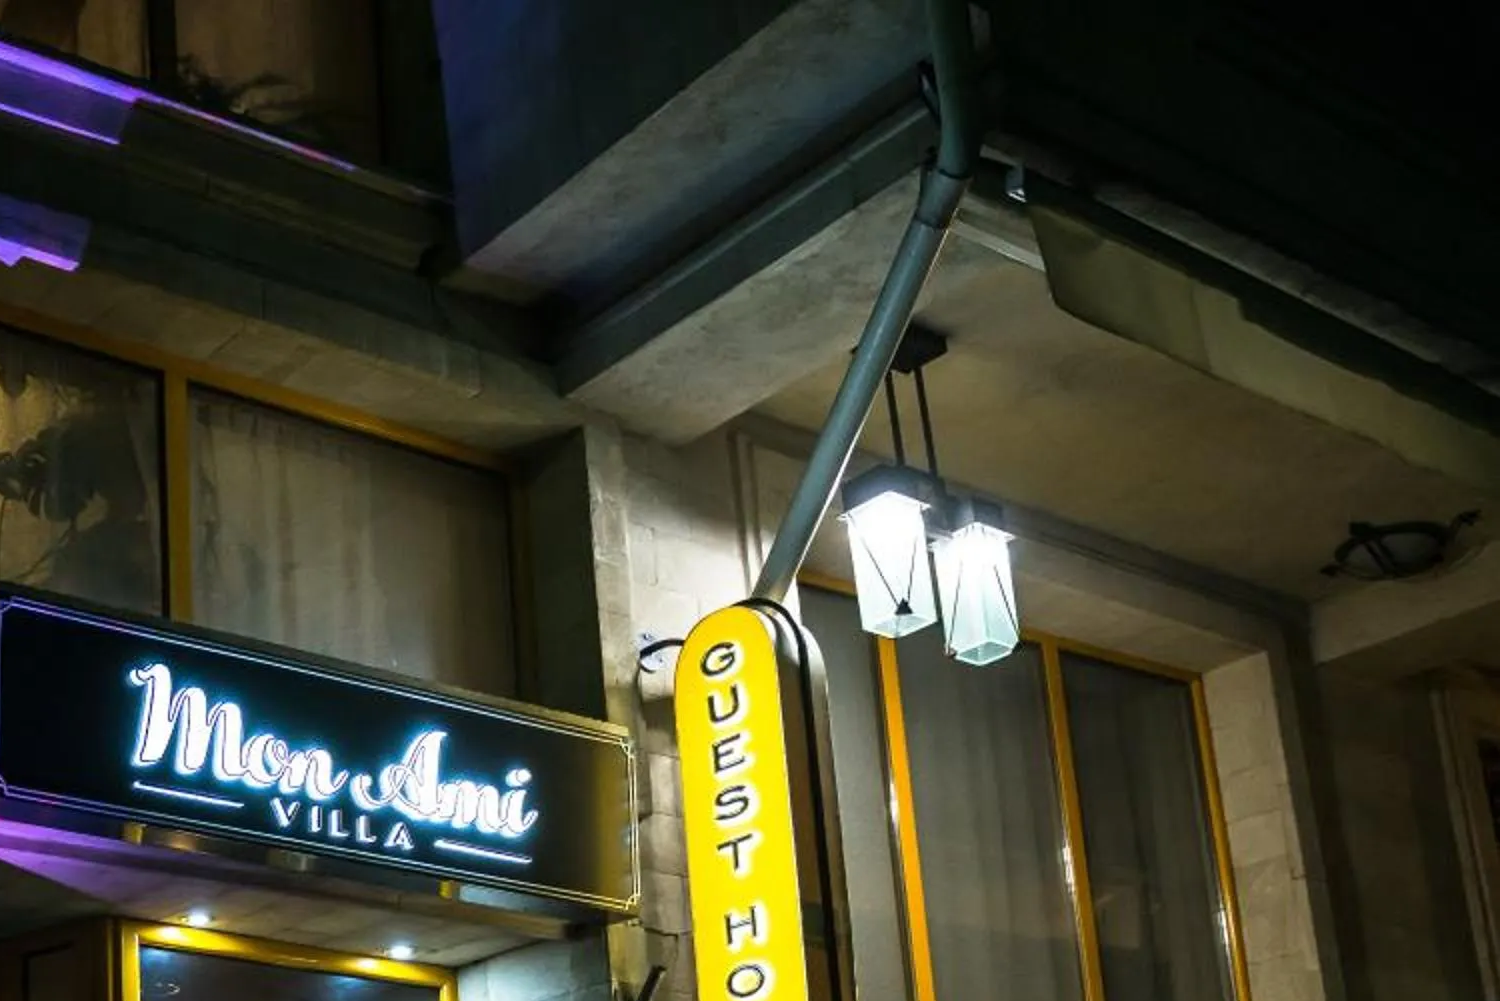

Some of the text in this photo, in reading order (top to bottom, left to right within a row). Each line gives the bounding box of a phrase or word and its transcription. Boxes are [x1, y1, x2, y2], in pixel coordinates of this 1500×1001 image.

[129, 662, 539, 838] Mon Ami
[269, 797, 415, 851] VILLA
[698, 641, 756, 874] GUEST
